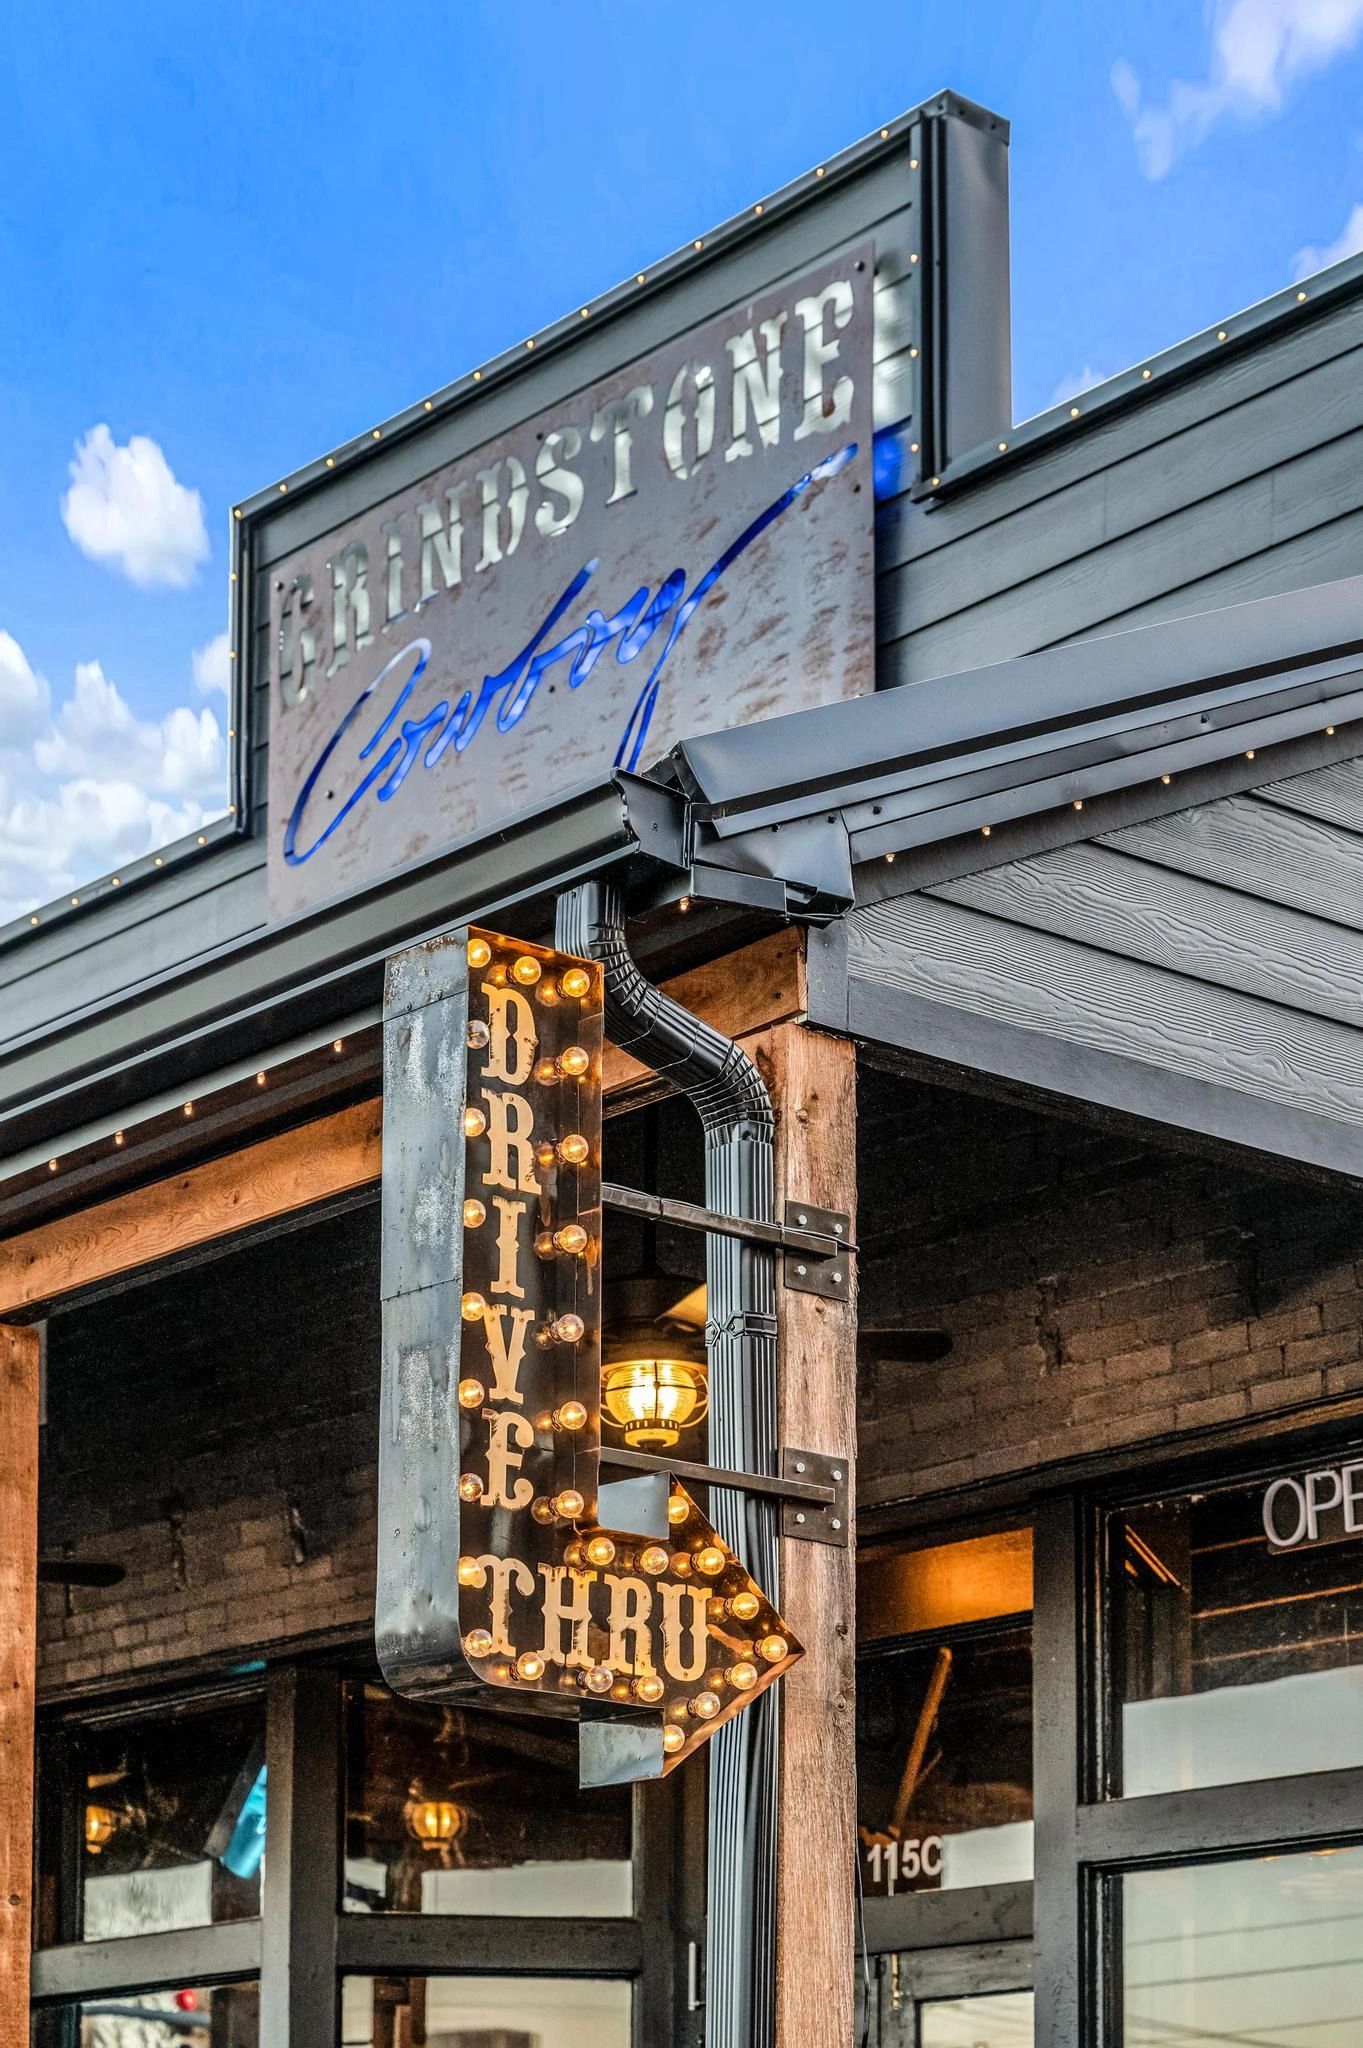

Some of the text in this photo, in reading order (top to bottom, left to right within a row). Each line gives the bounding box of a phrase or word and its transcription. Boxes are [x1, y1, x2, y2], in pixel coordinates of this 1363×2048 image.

[279, 280, 856, 709] GRINDSTONE
[480, 981, 541, 1511] DRIVE
[1262, 1463, 1363, 1547] OPE
[477, 1554, 713, 1682] THRU
[867, 1835, 944, 1883] 115C
